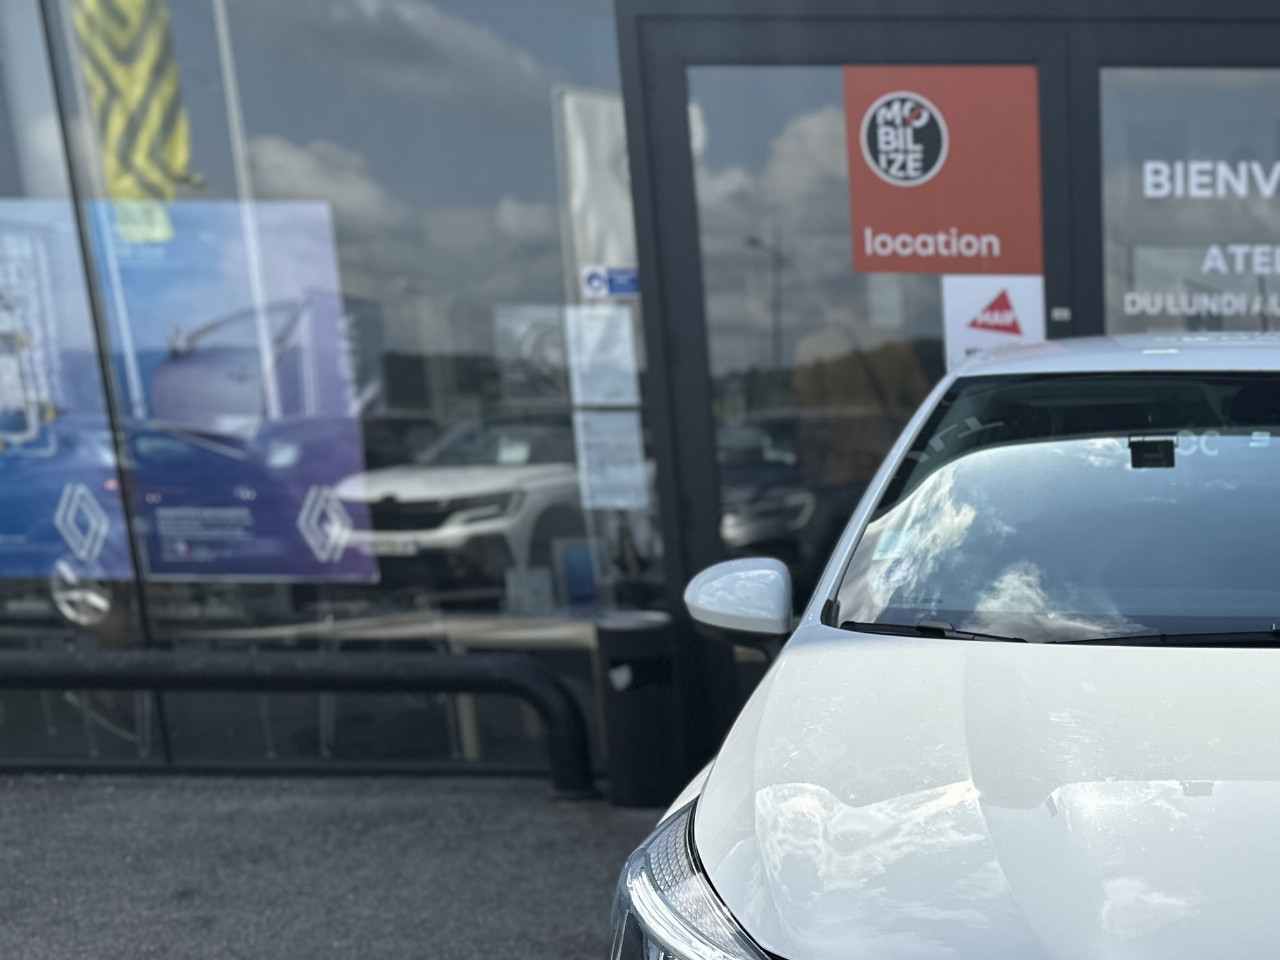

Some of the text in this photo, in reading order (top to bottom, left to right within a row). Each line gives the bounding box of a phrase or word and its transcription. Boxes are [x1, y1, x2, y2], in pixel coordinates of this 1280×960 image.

[864, 226, 1000, 257] location
[1123, 293, 1163, 317] DU
[1164, 293, 1246, 317] LUNDI
